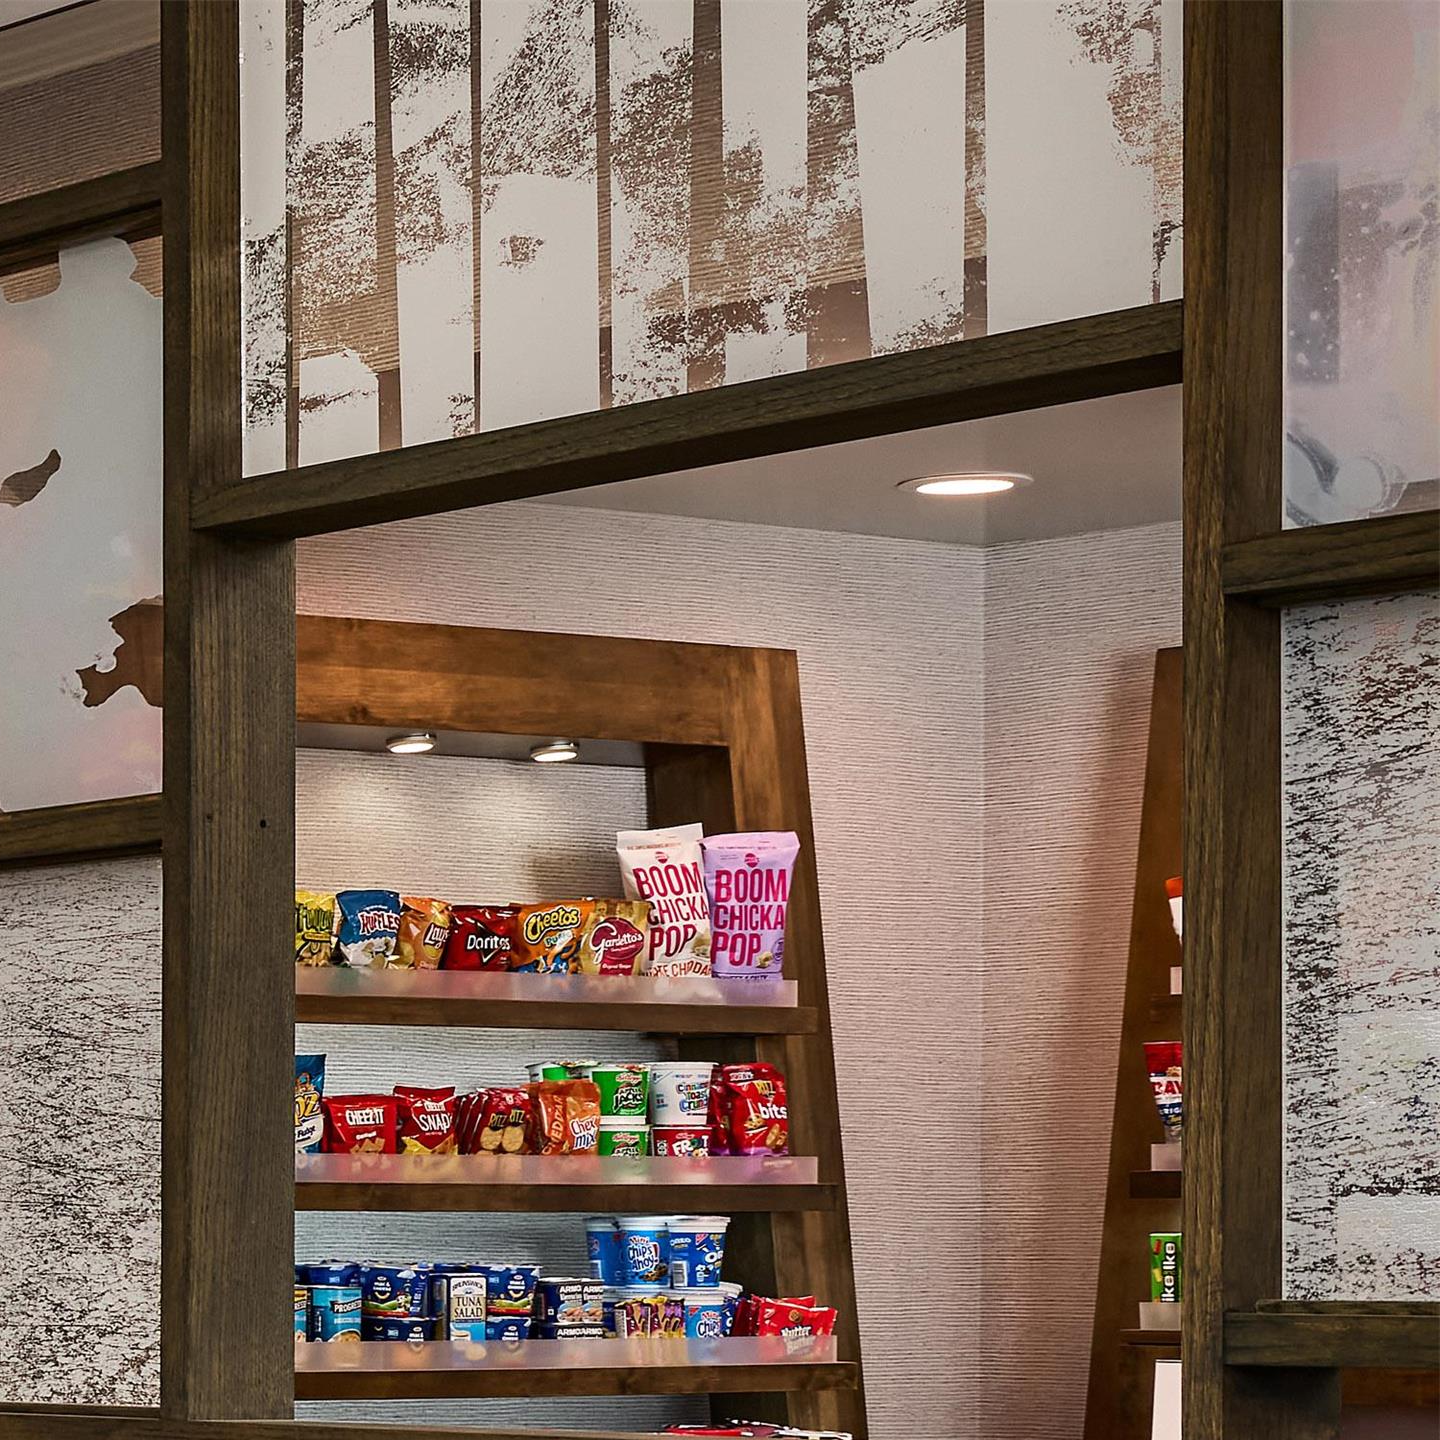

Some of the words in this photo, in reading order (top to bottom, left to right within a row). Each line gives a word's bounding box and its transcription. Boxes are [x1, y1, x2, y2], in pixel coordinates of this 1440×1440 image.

[632, 862, 704, 899] BOOM
[714, 868, 787, 903] BOOM
[647, 896, 710, 925] CHICKA
[713, 904, 784, 930] CHICKA
[525, 906, 580, 942] Cheetos
[466, 935, 511, 951] Doritos
[589, 922, 643, 964] Gardetto's
[649, 924, 697, 961] POP
[710, 931, 762, 967] POP
[757, 1102, 788, 1119] bits
[570, 1117, 597, 1136] Chex
[573, 1132, 597, 1150] mix
[628, 1244, 653, 1260] Chips
[454, 1307, 483, 1318] SALAD
[455, 1296, 482, 1307] TUNA
